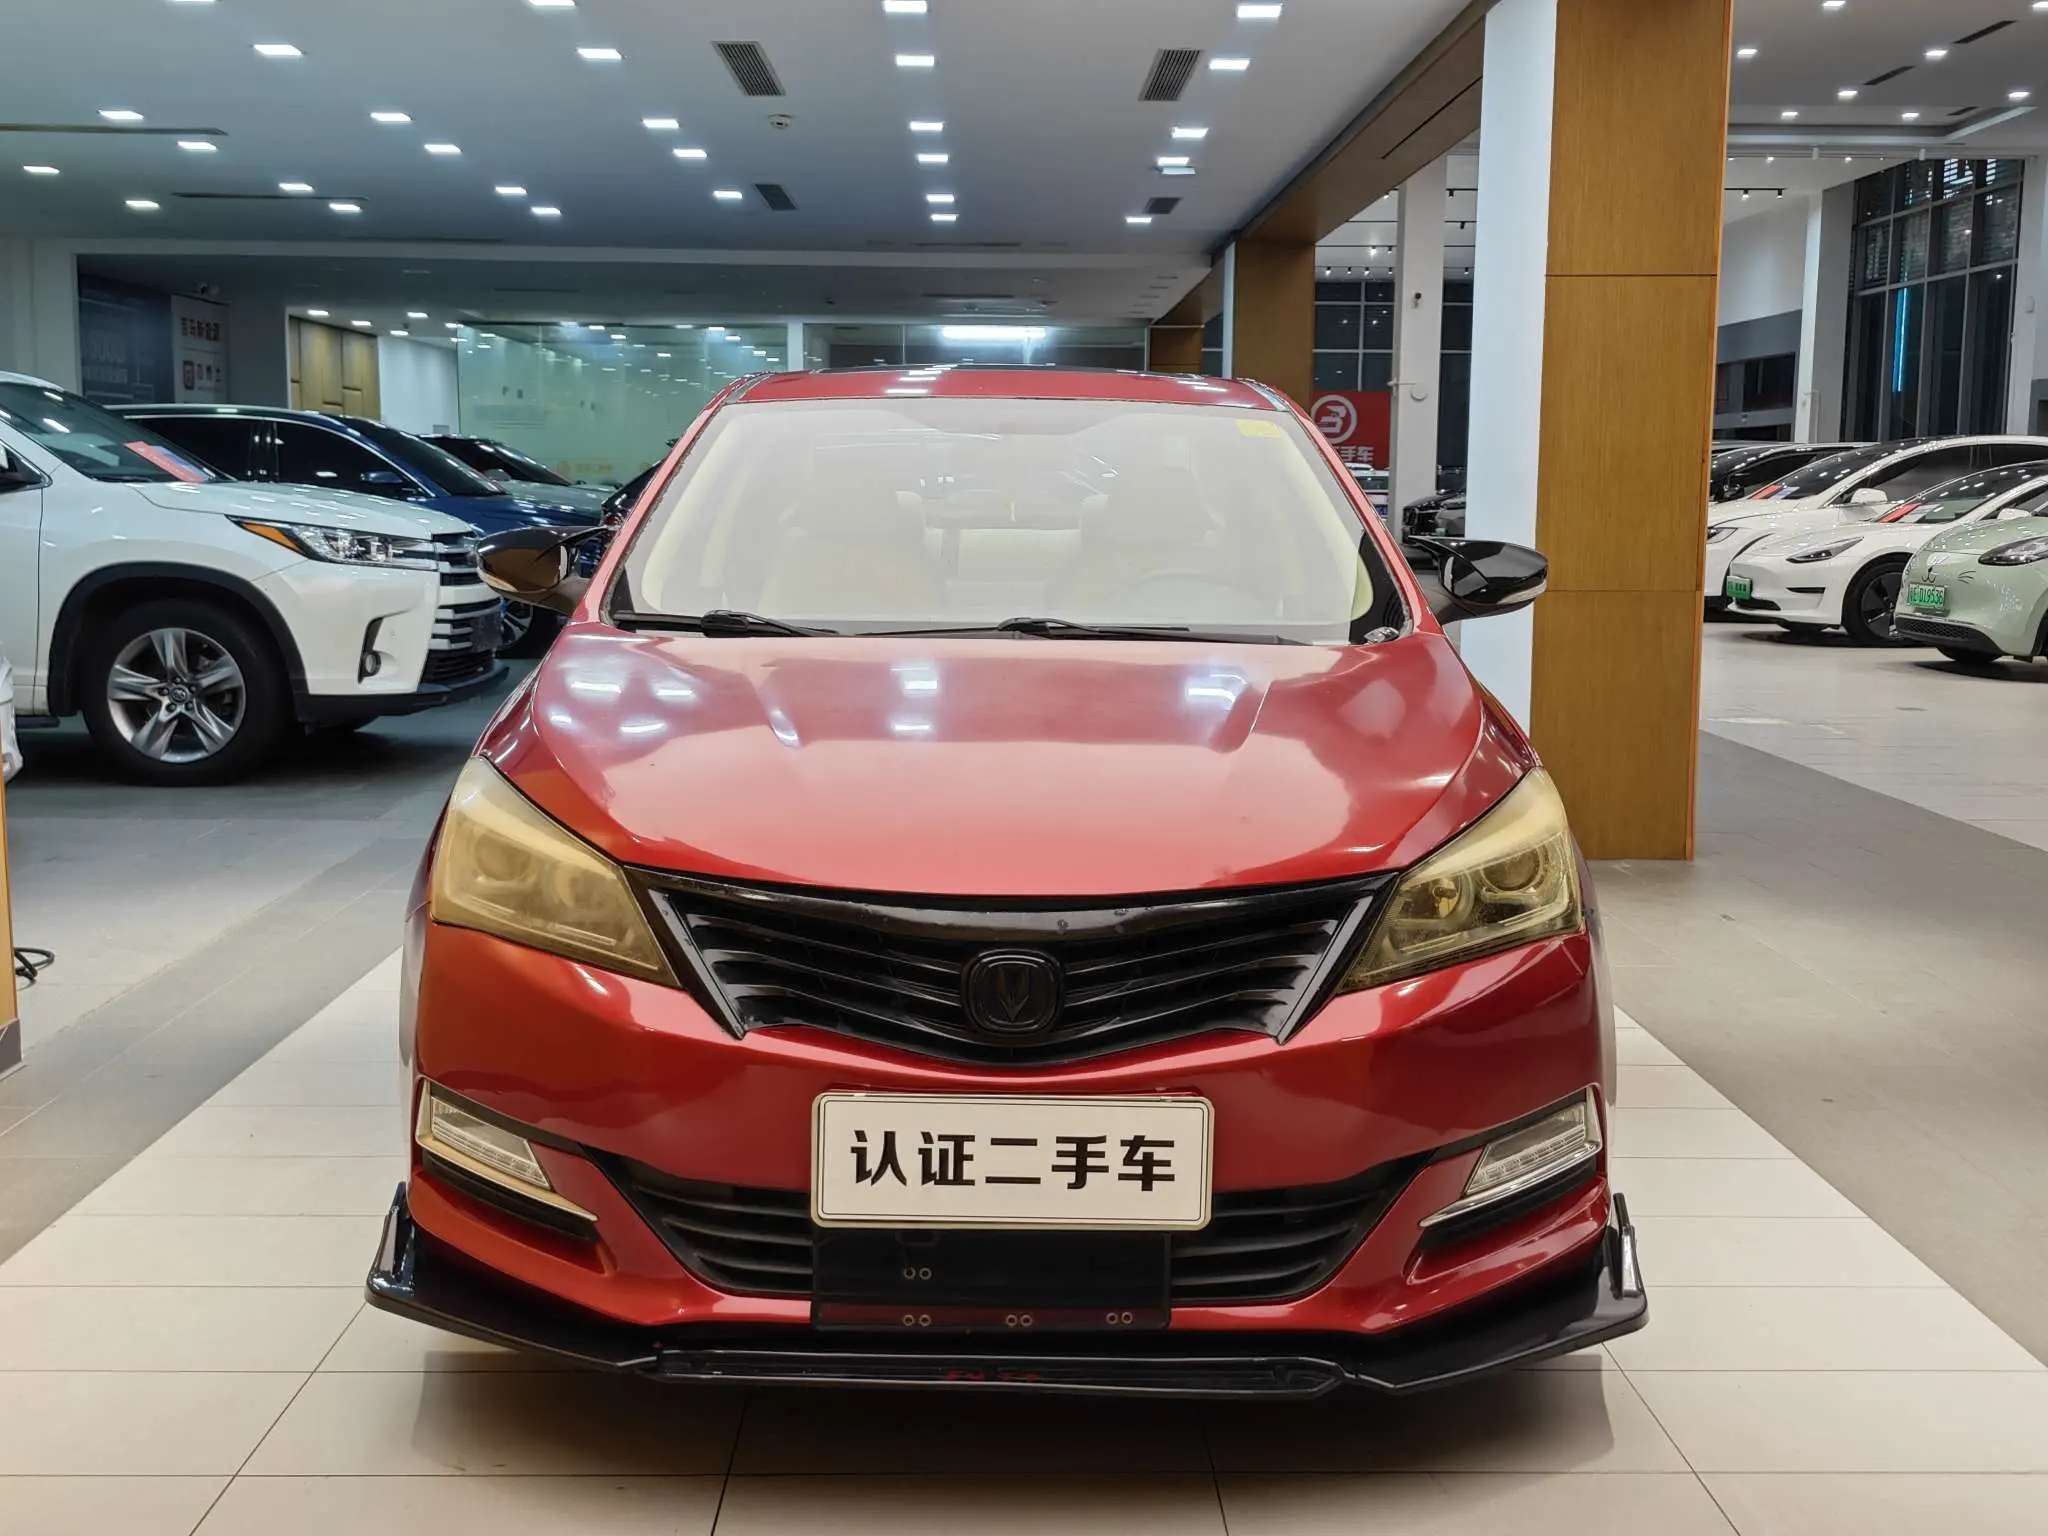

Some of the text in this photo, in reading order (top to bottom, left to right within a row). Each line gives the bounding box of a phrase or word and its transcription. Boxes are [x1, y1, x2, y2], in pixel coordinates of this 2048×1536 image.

[1334, 445, 1375, 463] 手车
[850, 1129, 1176, 1192] 认证二手车
